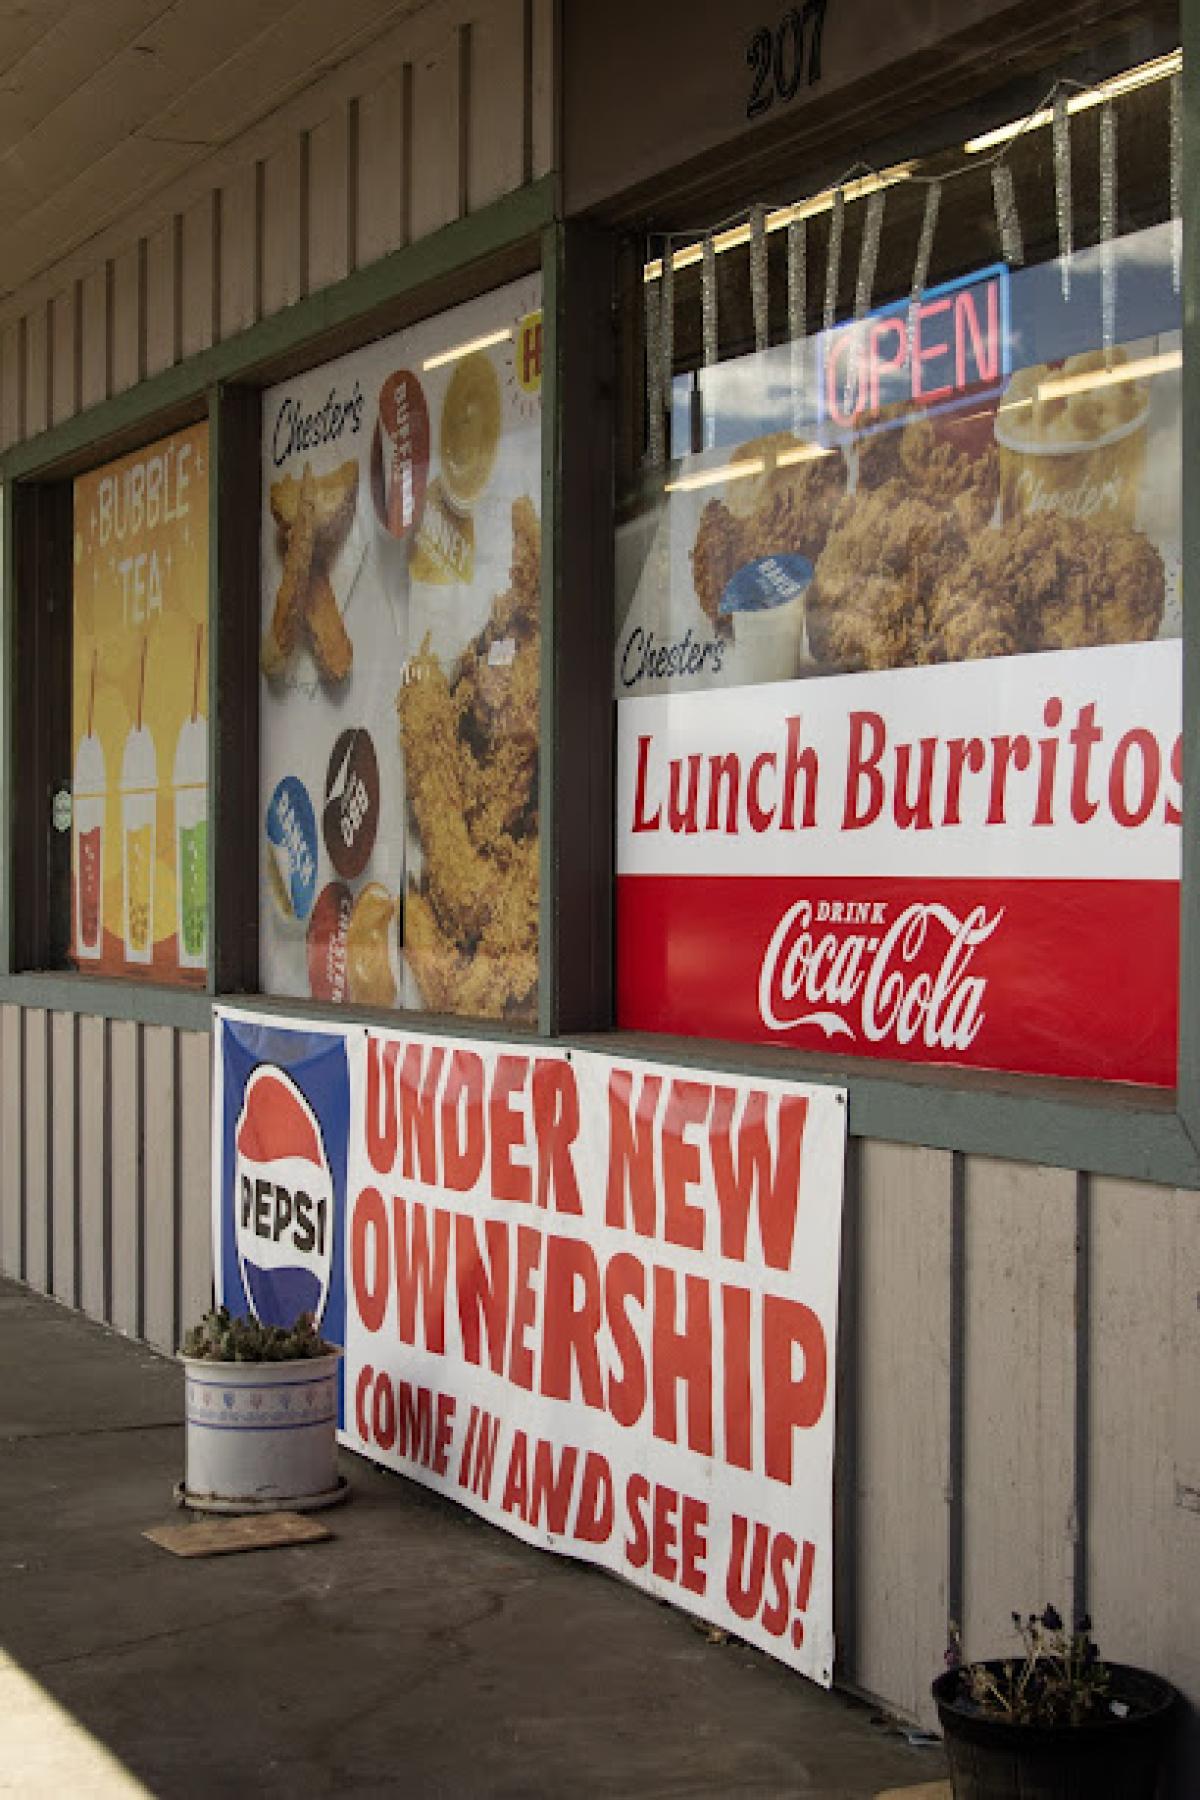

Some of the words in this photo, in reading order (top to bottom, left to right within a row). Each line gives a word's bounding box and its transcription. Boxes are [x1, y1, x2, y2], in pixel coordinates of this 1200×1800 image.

[746, 0, 827, 118] 207
[825, 283, 998, 427] OPEN
[274, 378, 363, 467] Chester's
[99, 443, 192, 545] BUBBLE
[117, 552, 164, 624] TEA
[620, 627, 725, 688] Chester's
[631, 715, 819, 834] Lunch
[815, 902, 888, 925] DRINK
[365, 1037, 583, 1215] UNDER
[606, 1067, 809, 1271] NEW
[240, 1174, 327, 1257] PEPSI
[351, 1187, 828, 1486] OWNERSHIP
[355, 1364, 455, 1475] COME
[459, 1403, 501, 1503] IN
[502, 1430, 615, 1545] AND
[626, 1472, 709, 1596] SEE
[725, 1513, 816, 1650] US!
